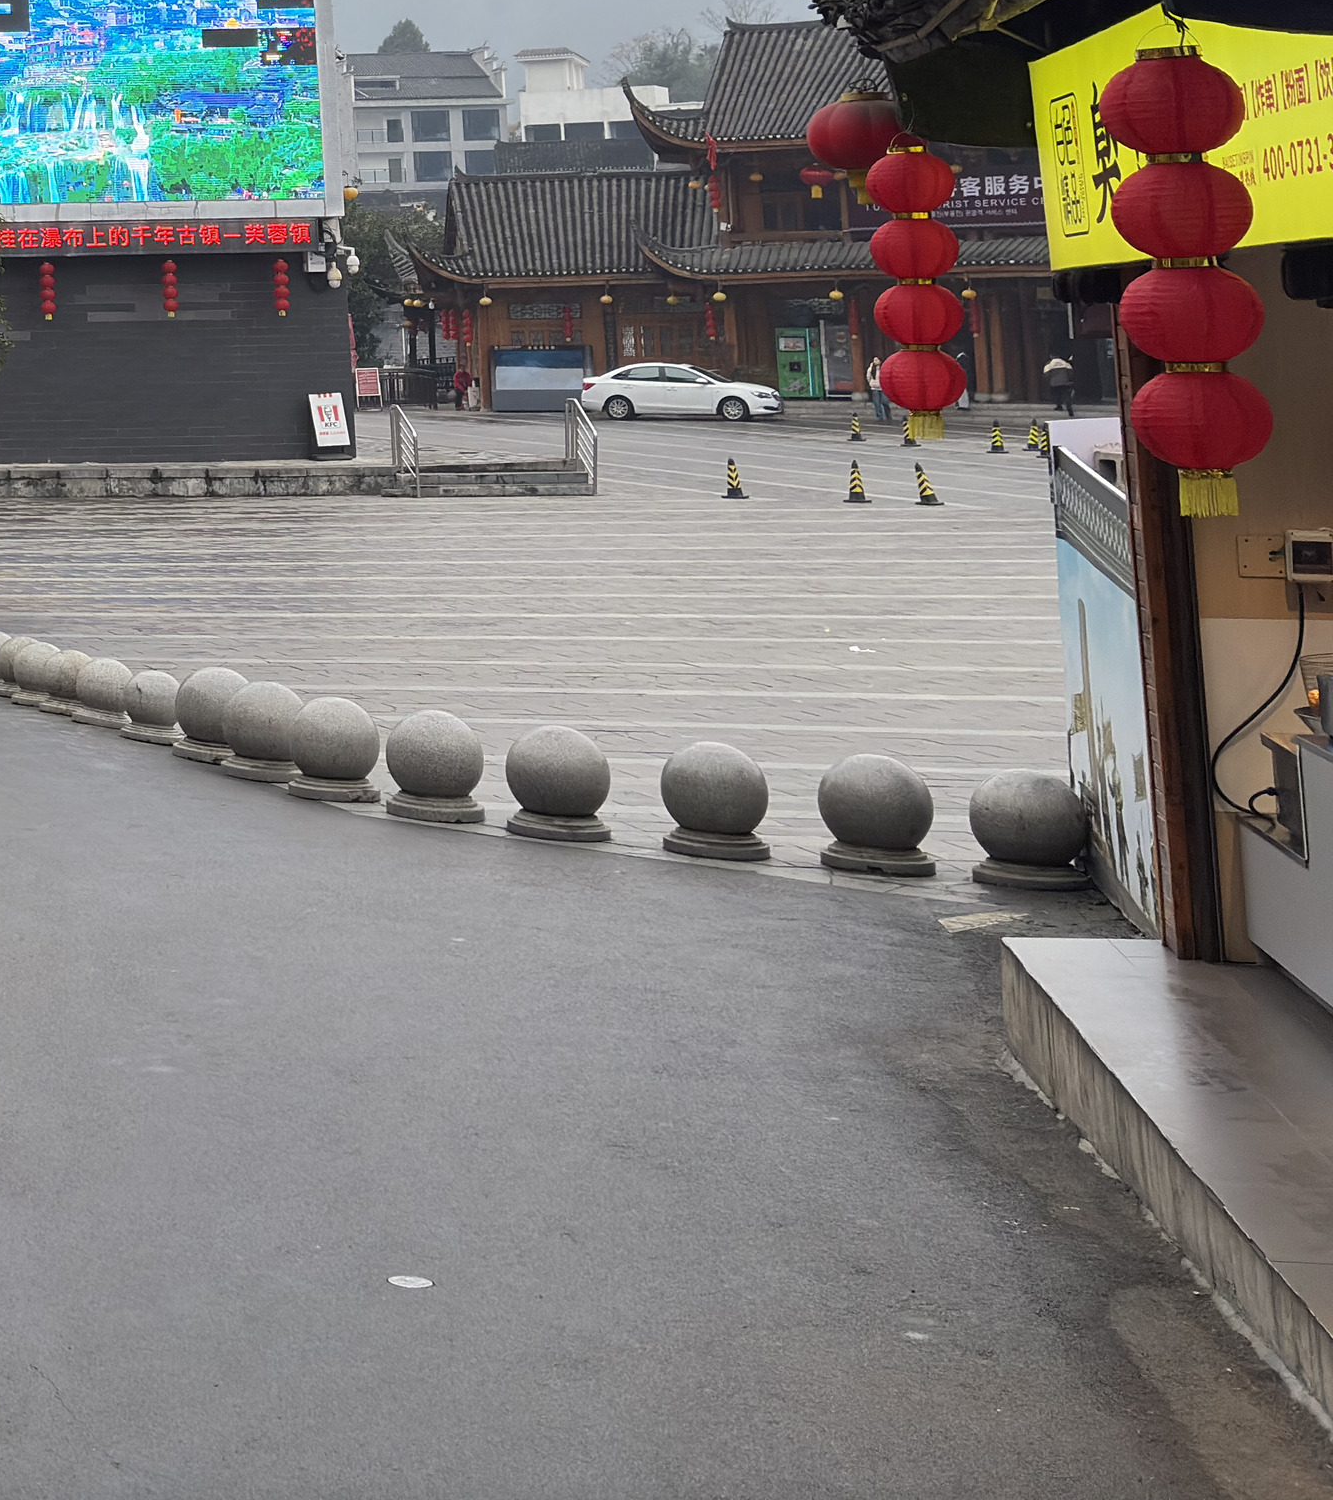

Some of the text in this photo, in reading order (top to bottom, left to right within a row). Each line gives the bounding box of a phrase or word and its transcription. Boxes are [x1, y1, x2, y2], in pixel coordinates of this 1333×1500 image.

[950, 174, 1044, 197] 客服务
[974, 197, 1027, 208] SERVICE
